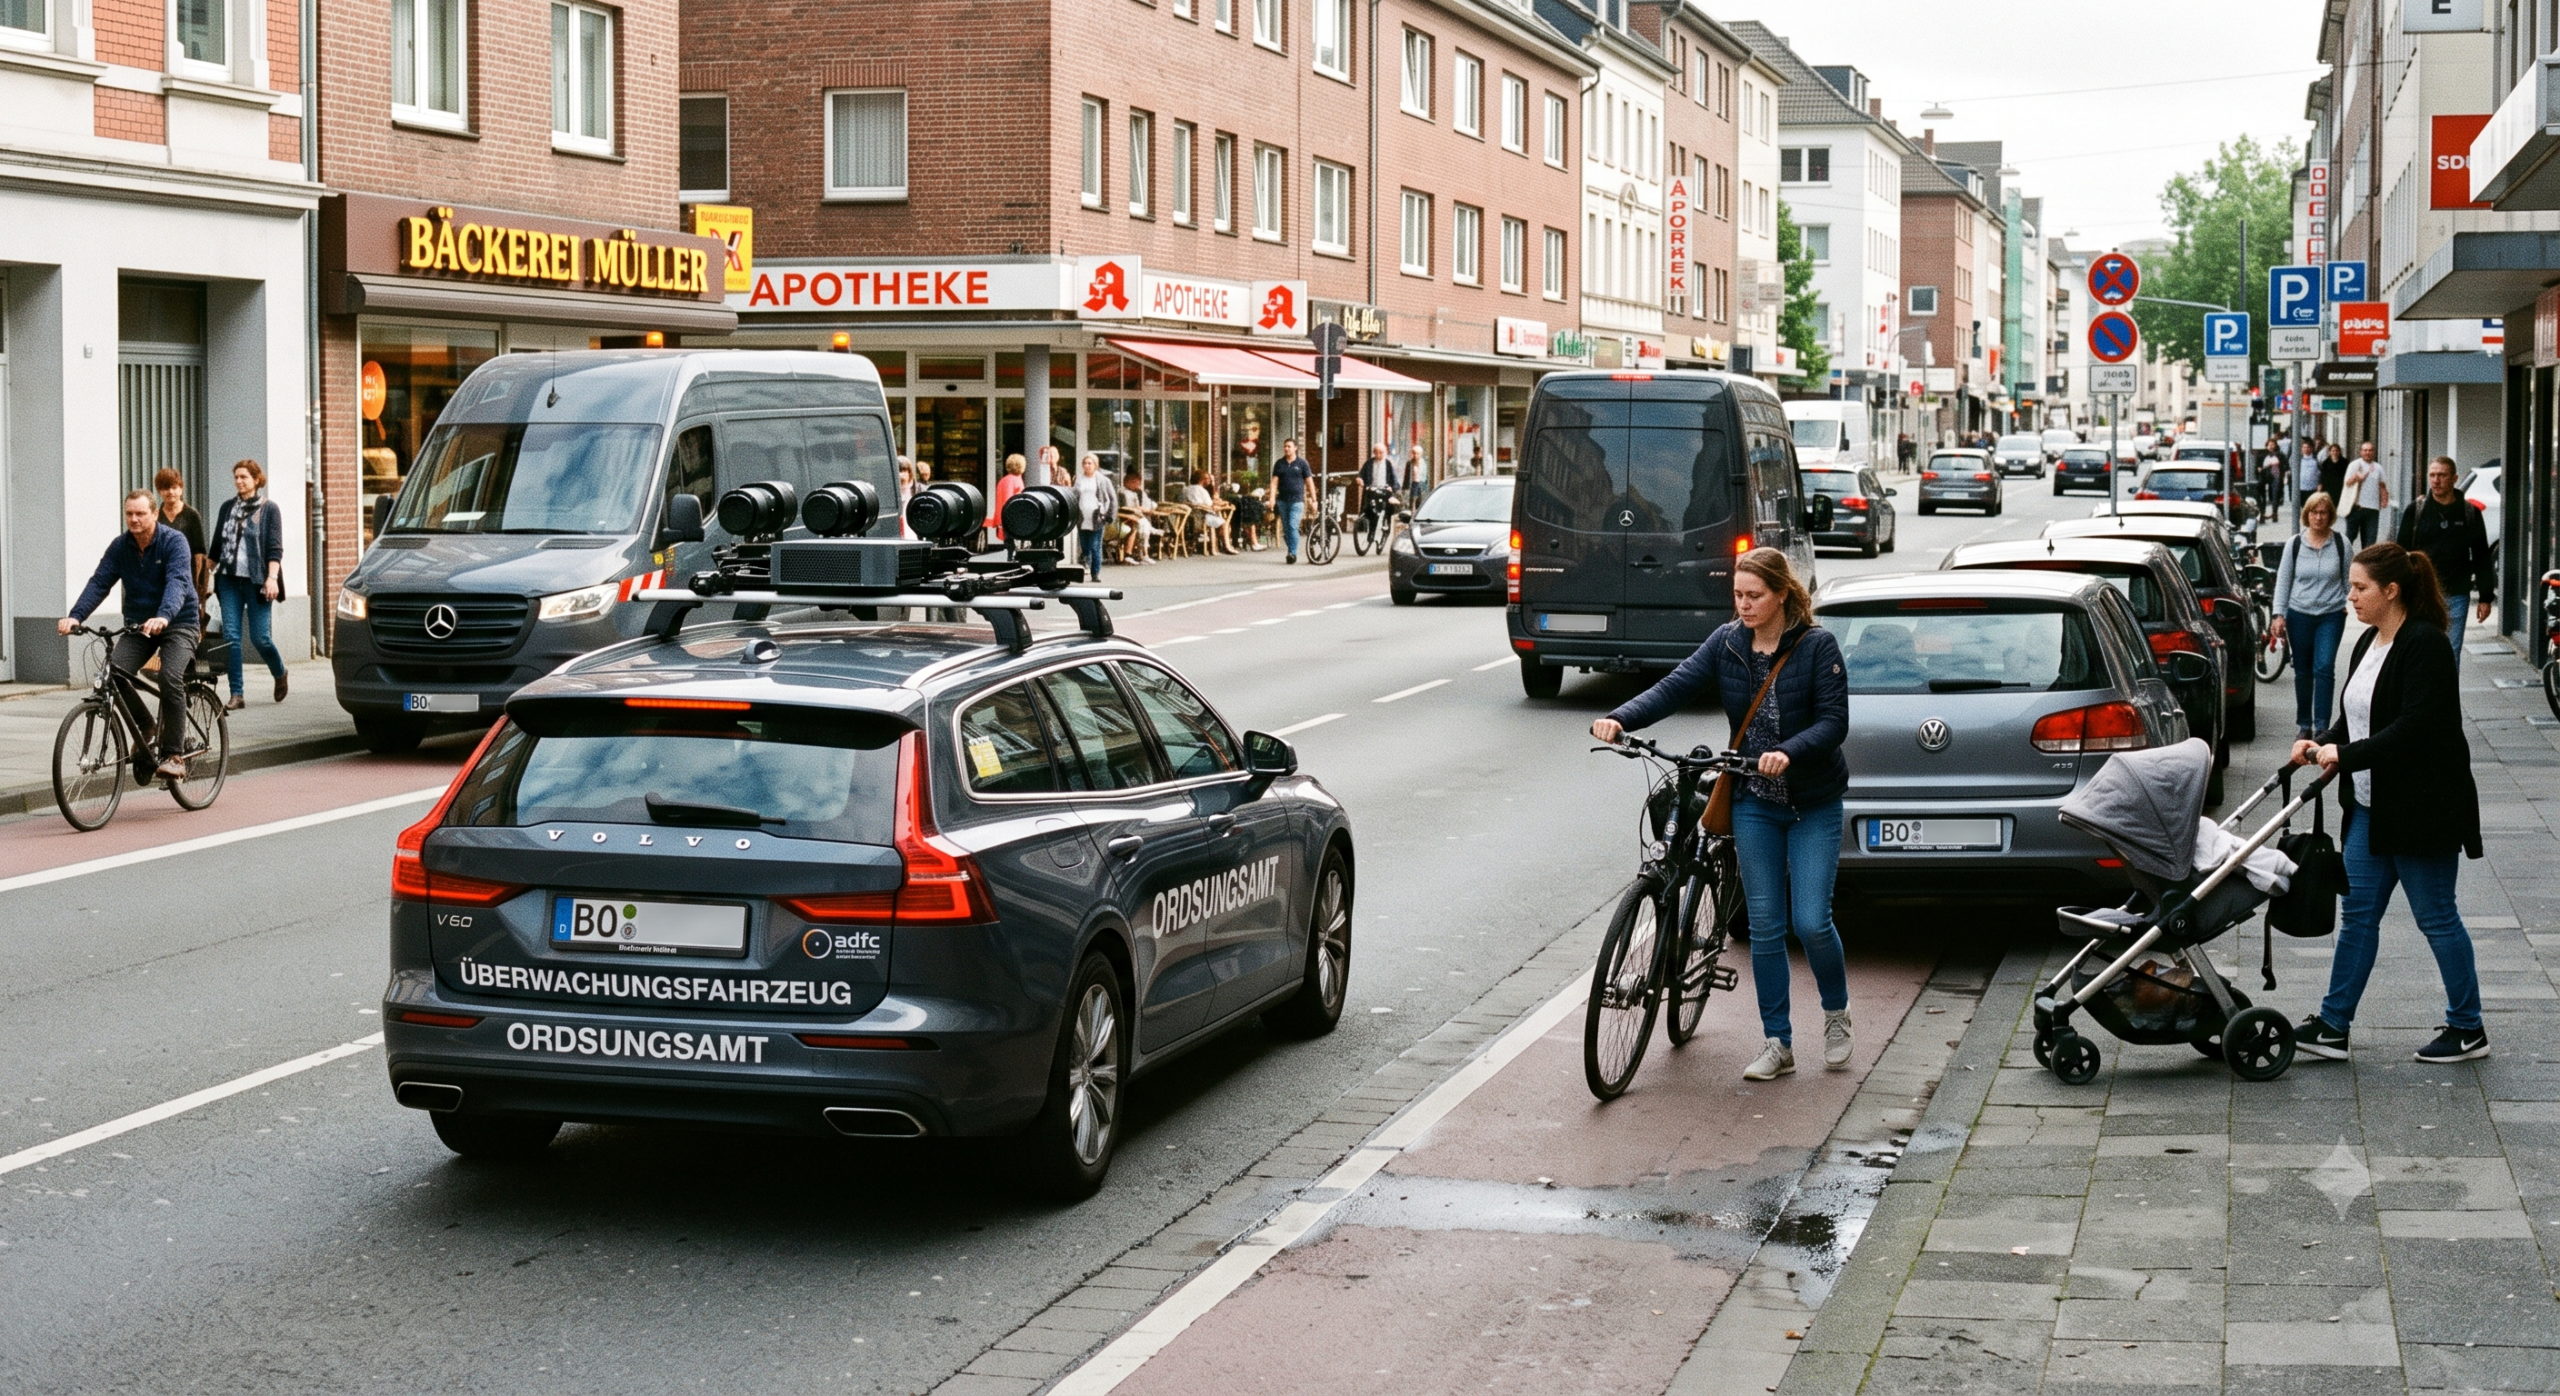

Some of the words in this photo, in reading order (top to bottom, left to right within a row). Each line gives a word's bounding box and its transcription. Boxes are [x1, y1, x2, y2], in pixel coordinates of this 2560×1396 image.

[2437, 155, 2471, 170] SD
[409, 206, 580, 281] BÄCKEREI
[593, 229, 708, 292] MÜLLER
[749, 271, 989, 306] APOTHEKE
[1153, 282, 1228, 319] APOTHEKE
[2280, 274, 2309, 319] P
[2214, 319, 2239, 352] P
[411, 695, 428, 710] BO
[547, 829, 751, 850] VOLVO
[1882, 822, 1909, 842] BO
[1152, 855, 1279, 939] ORDSUNGSAMT
[574, 904, 618, 938] BO
[834, 931, 880, 948] adfc
[460, 957, 852, 1005] ÜBERWACHUNGSFAHRZEUG
[506, 1022, 769, 1063] ORDSUNGSAMT
